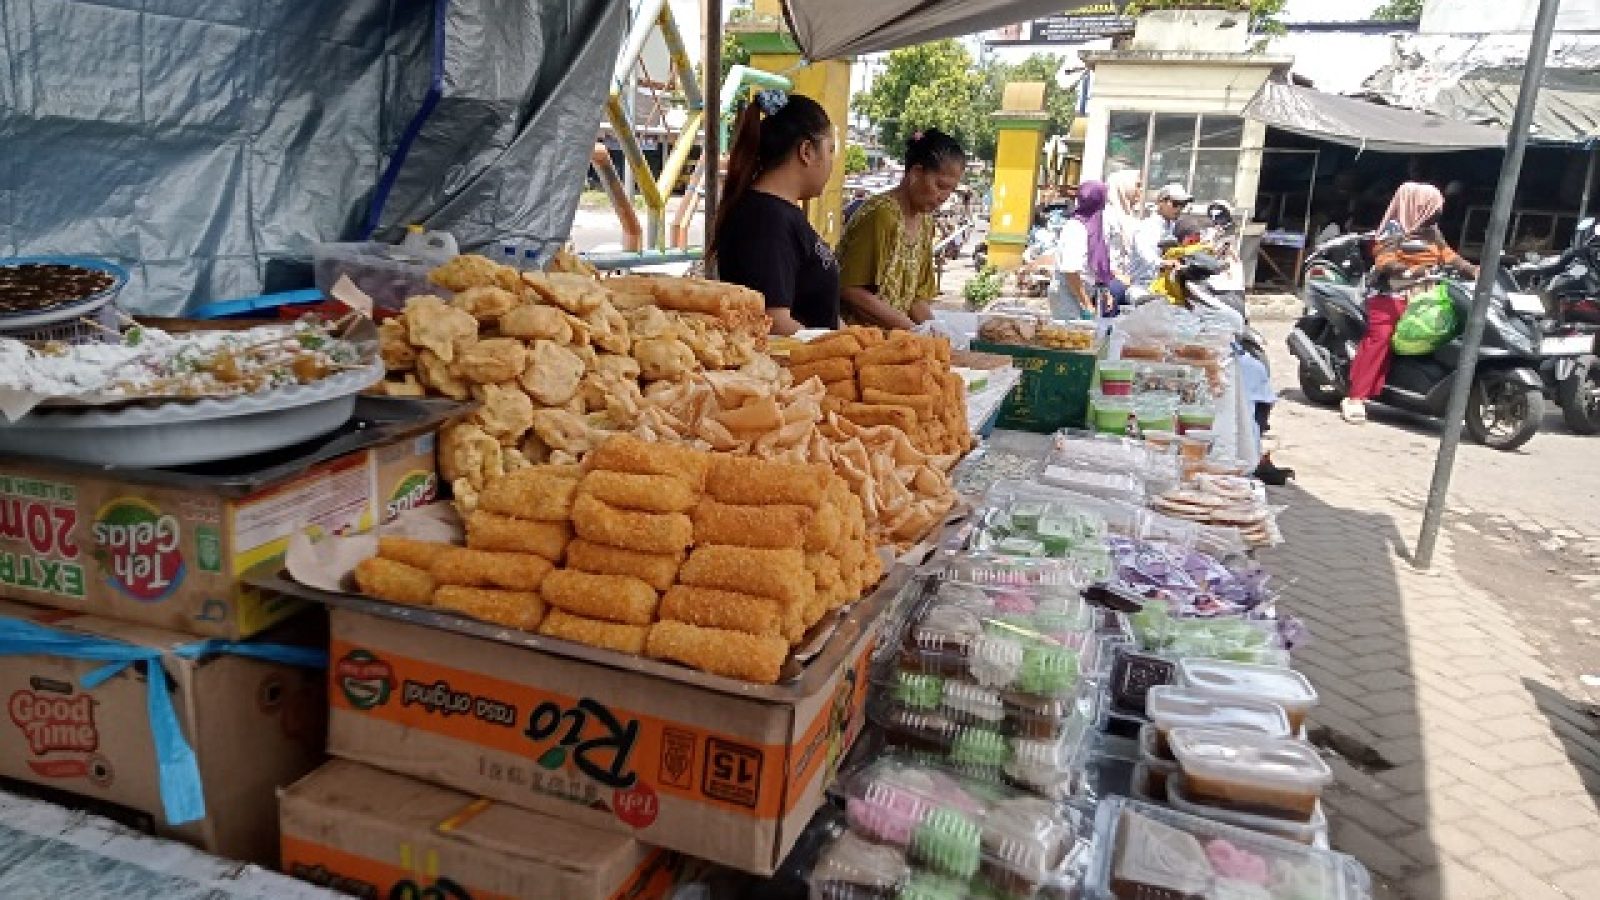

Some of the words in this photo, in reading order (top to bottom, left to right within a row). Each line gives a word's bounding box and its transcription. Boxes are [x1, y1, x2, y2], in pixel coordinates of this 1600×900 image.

[92, 514, 180, 554] Gelas
[114, 552, 170, 588] Teh
[11, 691, 91, 722] Good
[404, 683, 471, 713] original
[476, 699, 514, 725] rasa
[28, 722, 96, 750] Time
[525, 698, 640, 790] Rio
[714, 753, 753, 784] 15
[618, 791, 656, 816] Teh
